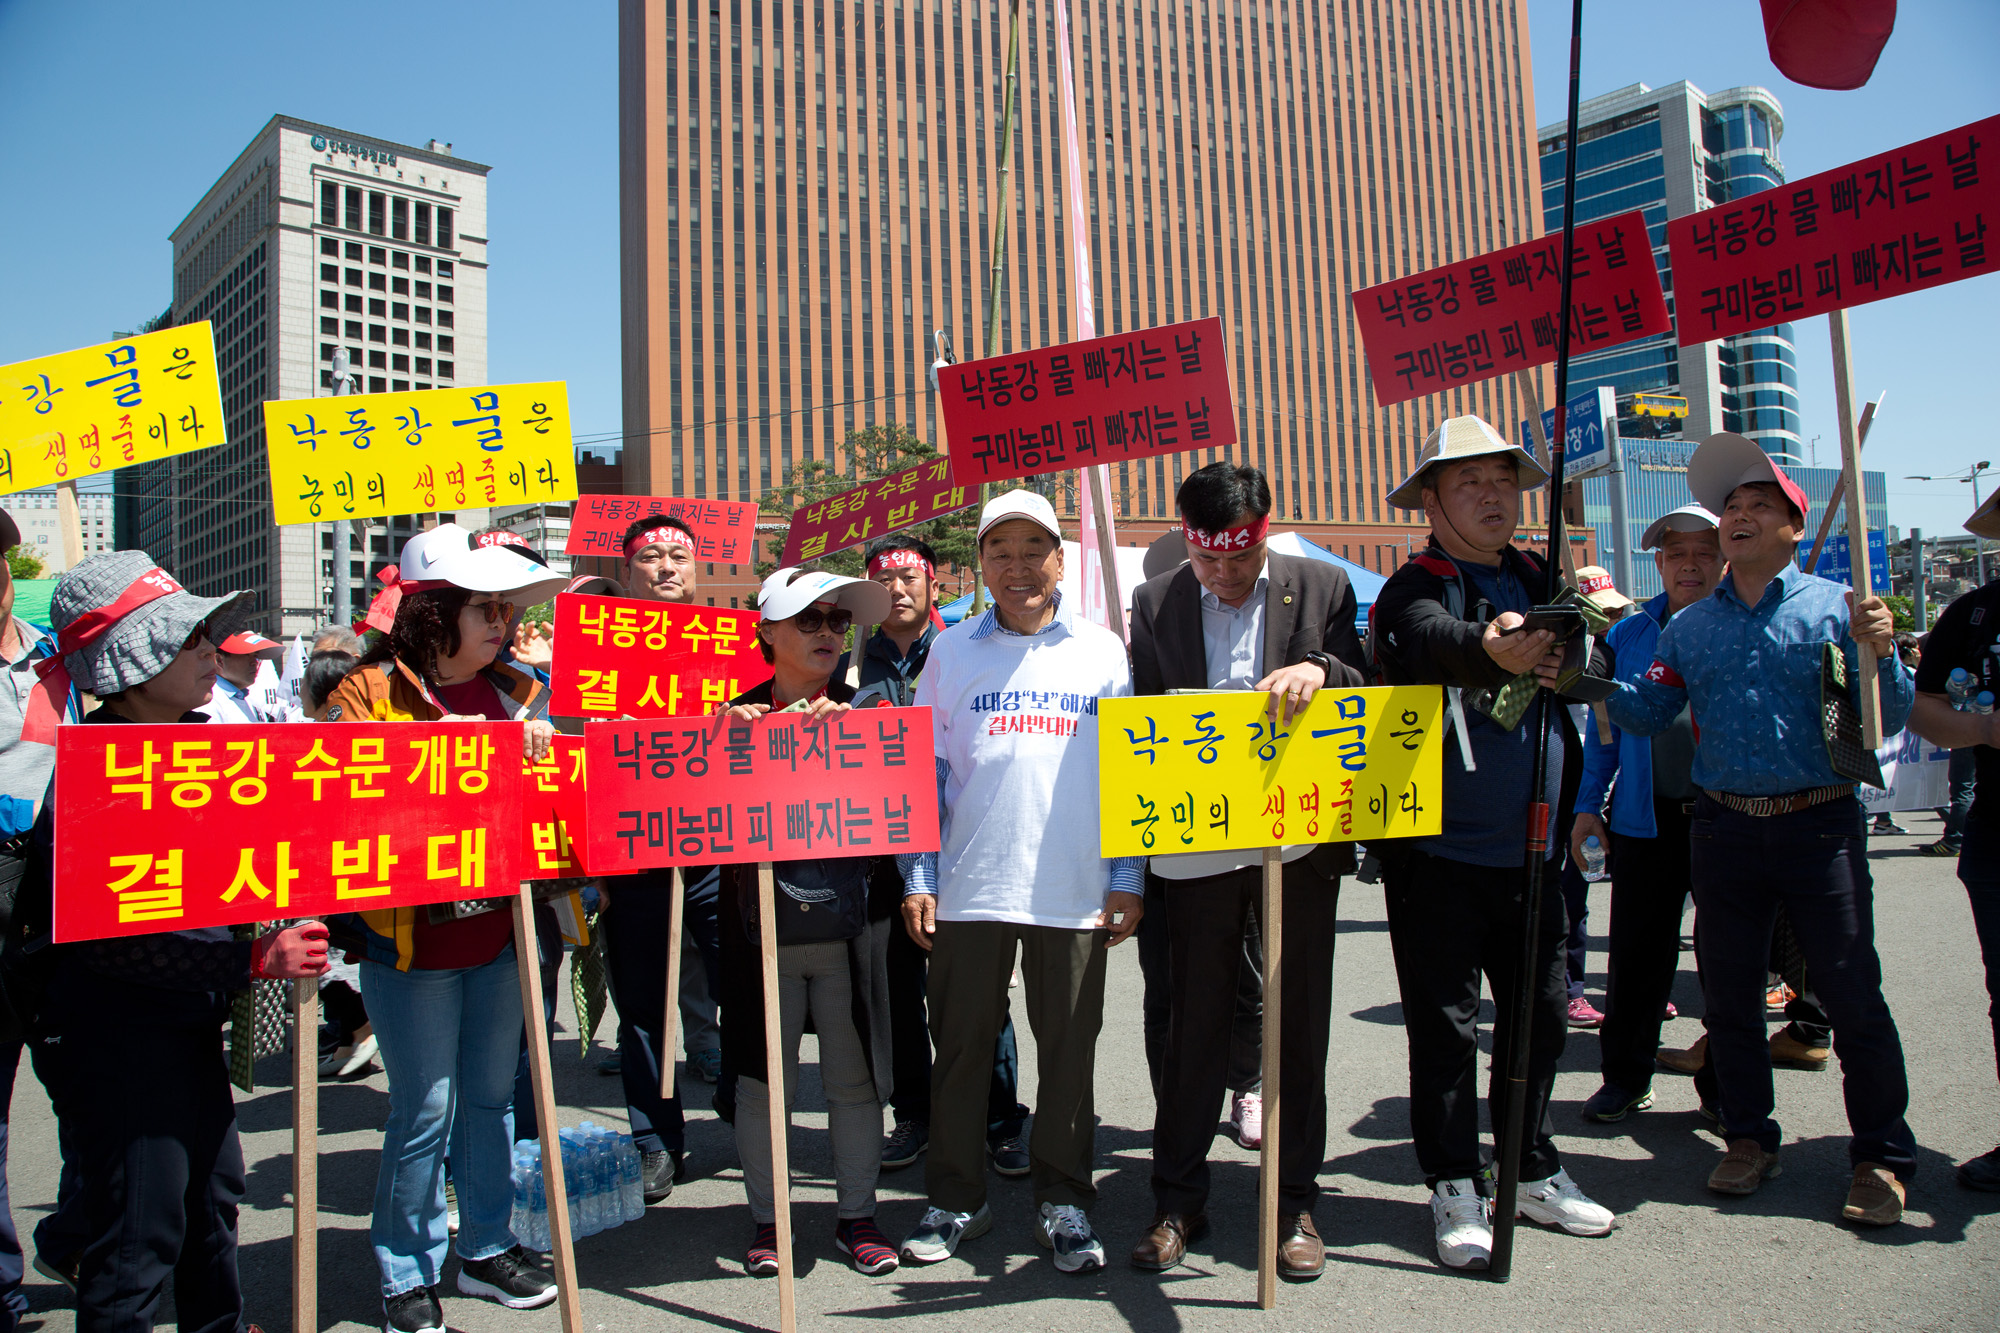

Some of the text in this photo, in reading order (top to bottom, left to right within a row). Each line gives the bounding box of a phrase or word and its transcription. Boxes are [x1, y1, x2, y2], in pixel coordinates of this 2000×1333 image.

[1692, 135, 1982, 260] 낙동강 물 빠지는 날
[1377, 227, 1627, 328] 낙동강 물 빠지는 날
[1699, 213, 1987, 330] 구미농민 피 빠지는 날
[1394, 329, 1494, 390] 구미농민
[1502, 320, 1527, 361] 피
[1613, 289, 1643, 332] 날
[22, 373, 65, 415] 강
[961, 331, 1201, 409] 낙동강 물 빠지는 날
[972, 397, 1210, 474] 구미농민 피 빠지는 날
[299, 473, 385, 517] 농민의
[591, 500, 642, 520] 낙동강
[669, 503, 720, 525] 빠지는
[727, 506, 744, 526] 날
[806, 459, 948, 525] 낙동강 수문 개
[583, 530, 625, 552] 구미농
[722, 538, 737, 559] 날
[579, 604, 672, 651] 낙동강
[680, 613, 740, 656] 수문
[576, 669, 742, 716] 결사반
[613, 718, 908, 780] 낙동강 물 빠지는 날
[988, 714, 1078, 737] 결사반대!!
[1123, 710, 1289, 766] 낙동강
[105, 734, 495, 810] 낙동강 수문 개방
[522, 747, 587, 791] 문 개
[616, 794, 911, 859] 구미농민 피 빠지는 날
[1131, 791, 1229, 849] 농민의
